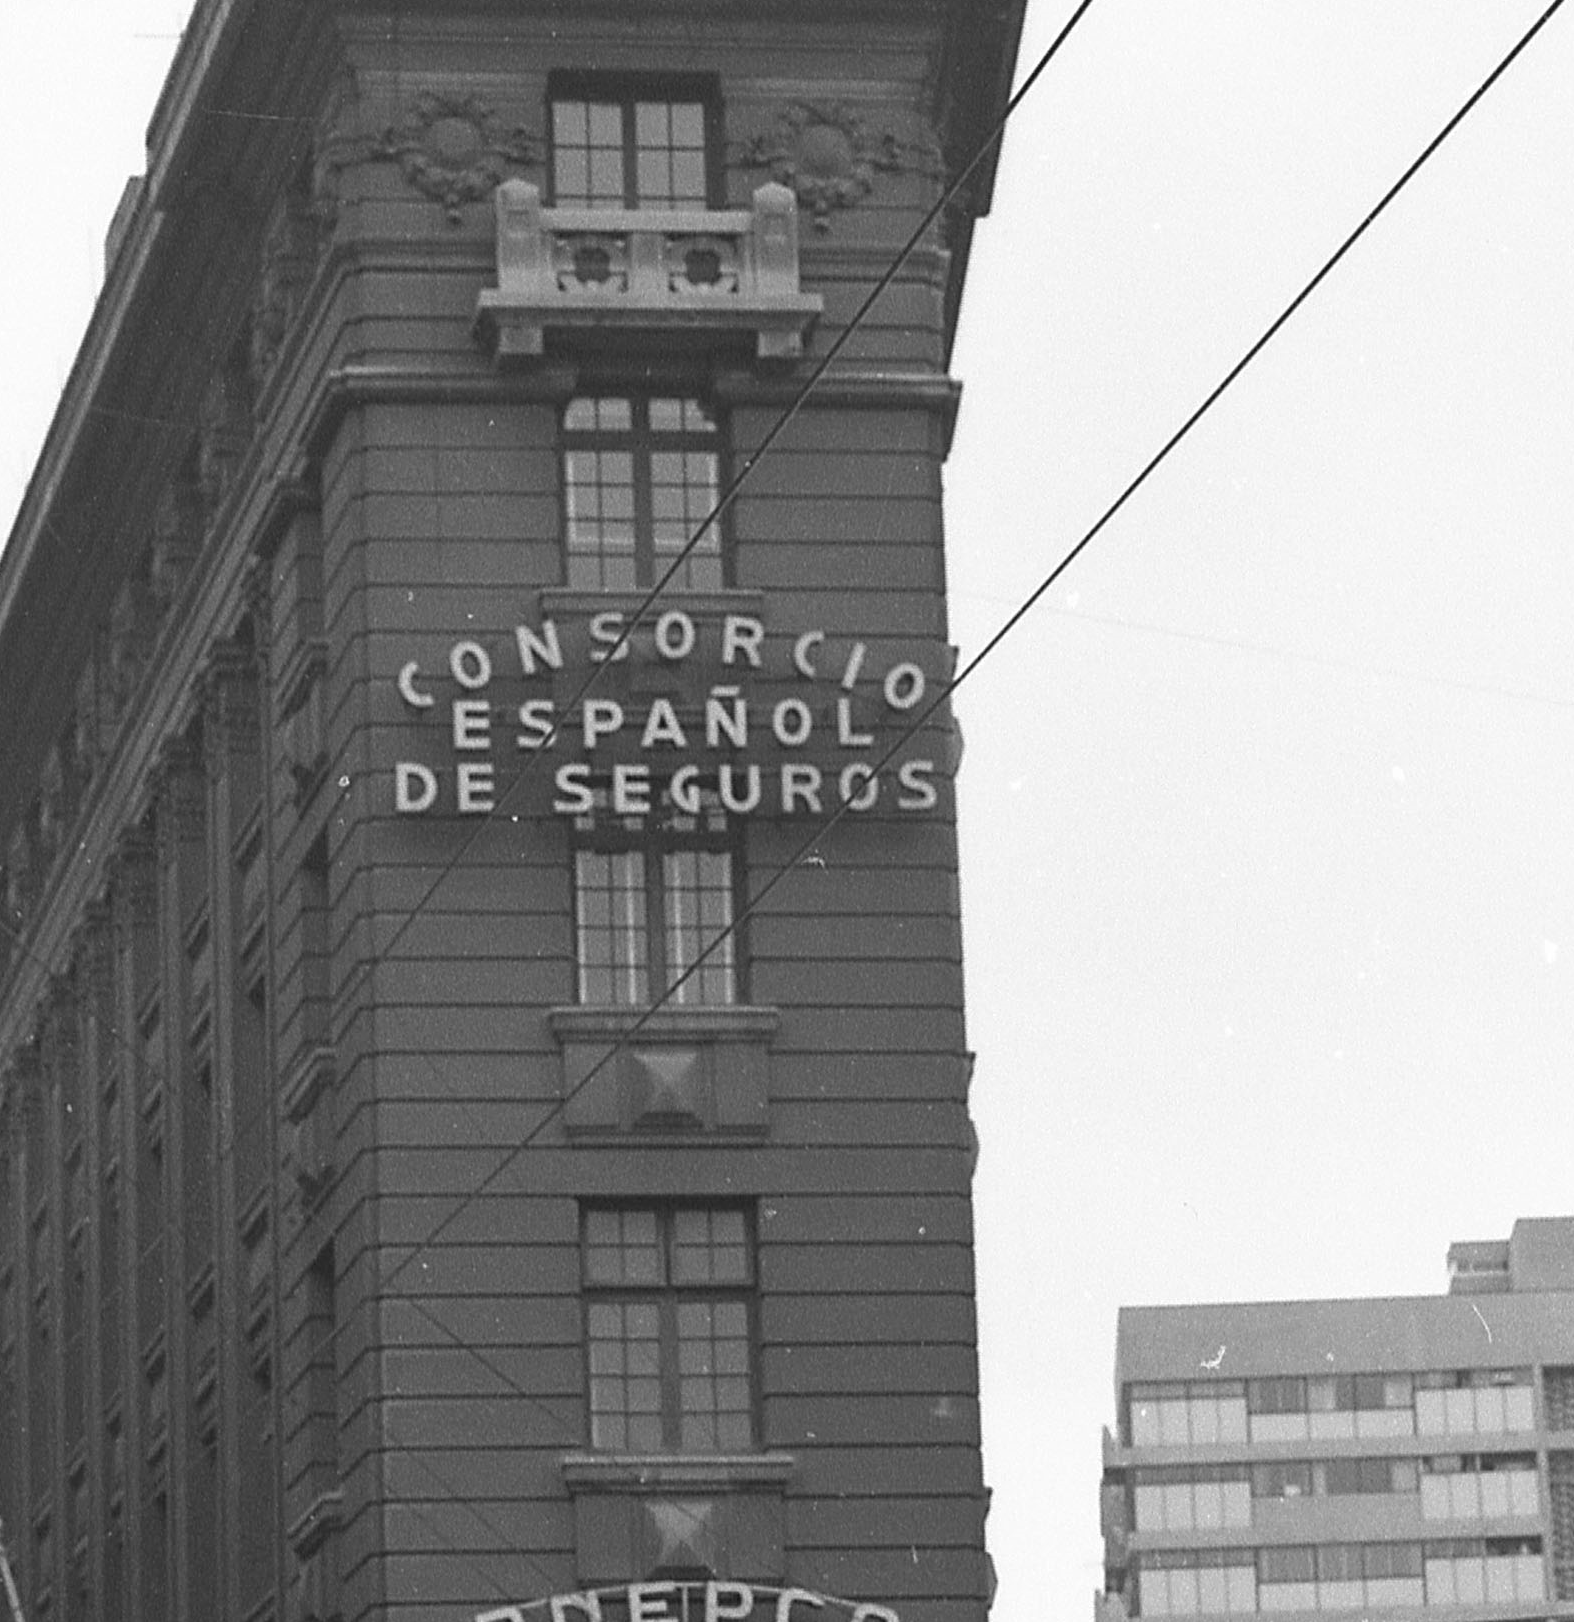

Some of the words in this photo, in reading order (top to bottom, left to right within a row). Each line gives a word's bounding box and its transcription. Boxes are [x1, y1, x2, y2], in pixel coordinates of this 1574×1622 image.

[398, 611, 927, 710] CONSORCIO
[453, 686, 875, 751] ESPAÑOL
[396, 763, 496, 813] DE
[554, 760, 937, 815] SEGUROS
